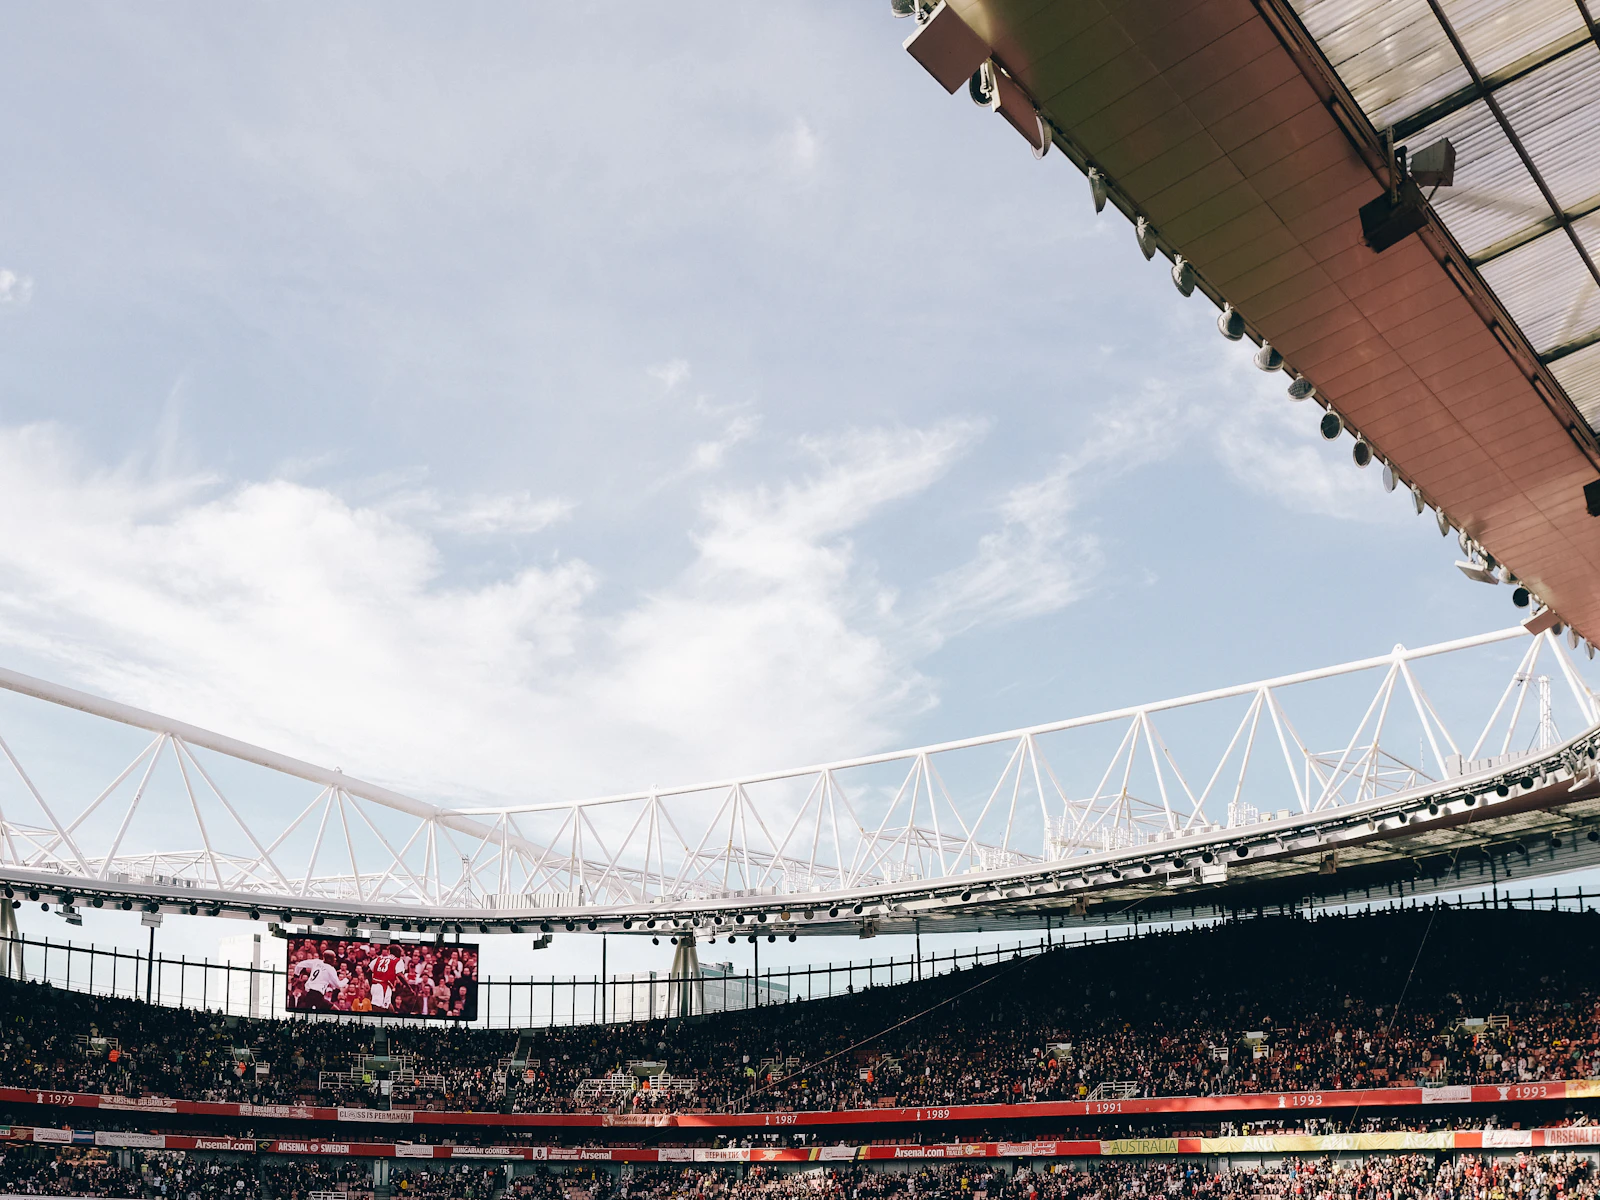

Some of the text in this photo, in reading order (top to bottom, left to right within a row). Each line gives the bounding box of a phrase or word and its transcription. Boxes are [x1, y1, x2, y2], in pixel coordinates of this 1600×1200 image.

[376, 957, 391, 973] 23
[310, 969, 320, 981] 9
[1515, 1085, 1547, 1099] 1993
[49, 1094, 75, 1105] 1979
[1292, 1094, 1323, 1106] 1993
[239, 1104, 290, 1115] MEN BECAME GODS
[926, 1109, 950, 1119] 1989
[1096, 1102, 1122, 1114] 1991
[374, 1112, 411, 1120] PERMANENT
[775, 1115, 798, 1125] 1987
[1550, 1129, 1589, 1144] ARSENAL
[195, 1139, 253, 1151] Arsenal.com
[278, 1142, 349, 1154] ARSENAL SWEDEN
[1111, 1140, 1177, 1154] AUSTRALIA
[580, 1150, 612, 1160] Arsenal
[894, 1147, 945, 1158] Arsenal.com
